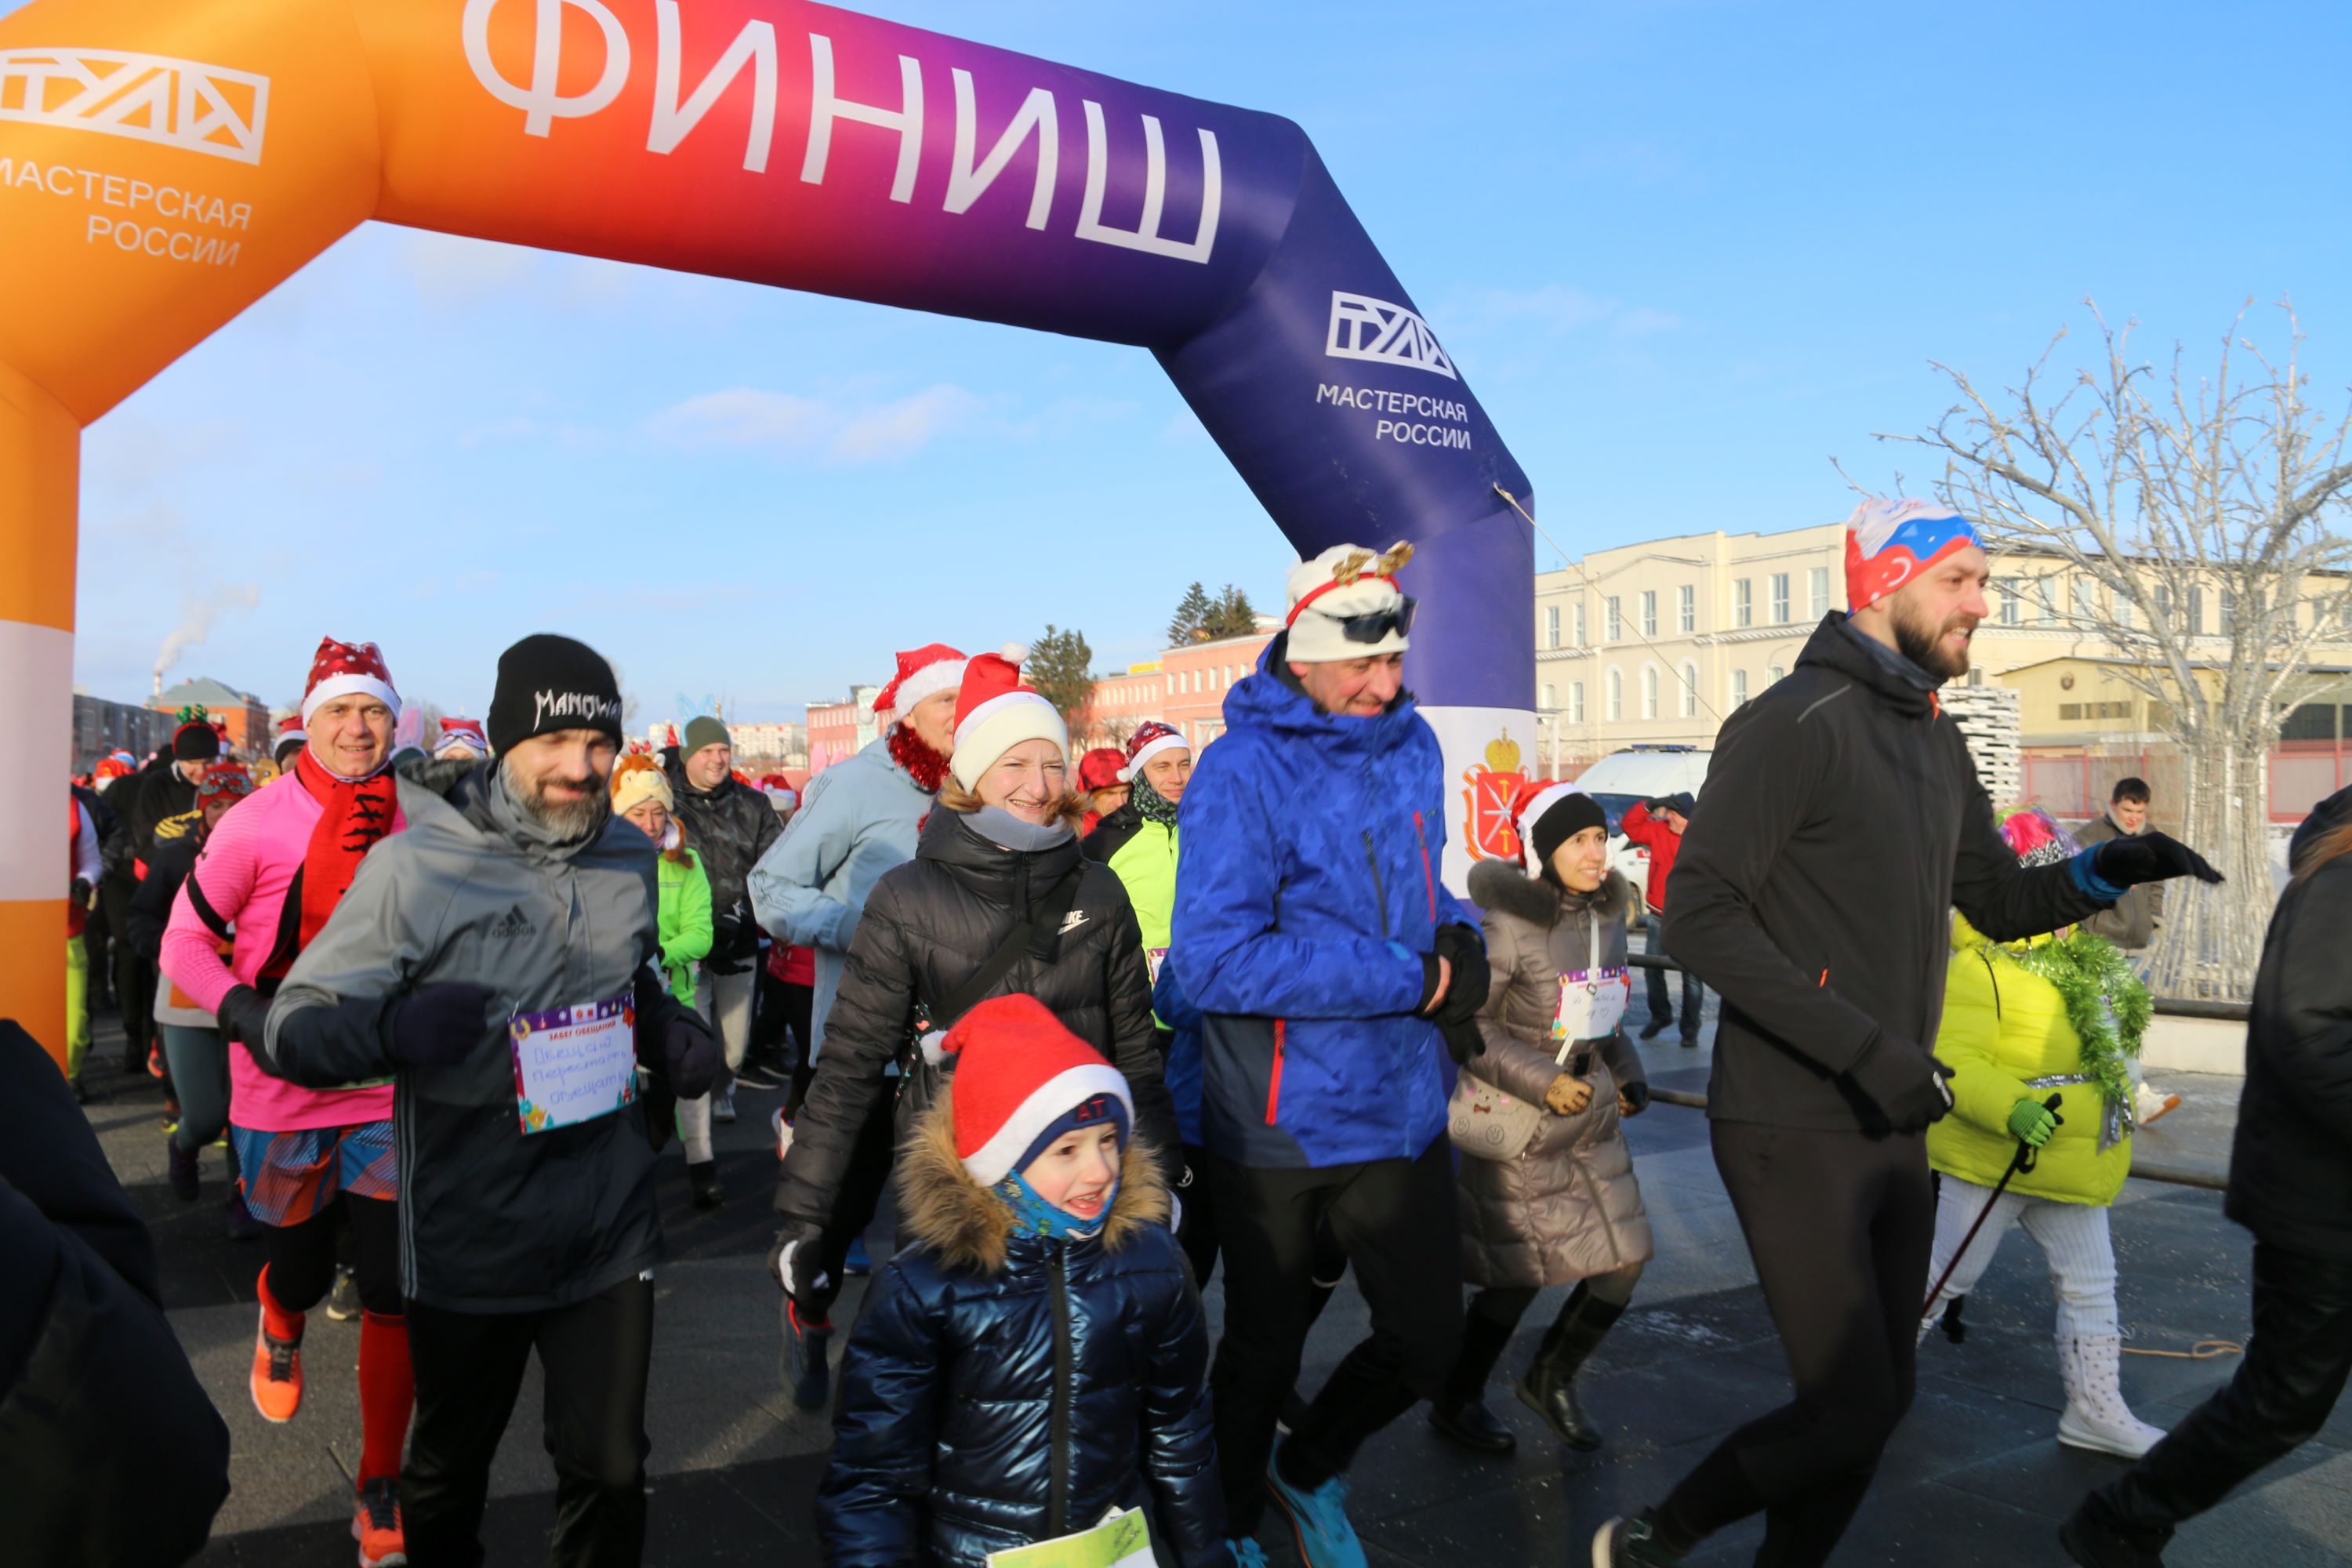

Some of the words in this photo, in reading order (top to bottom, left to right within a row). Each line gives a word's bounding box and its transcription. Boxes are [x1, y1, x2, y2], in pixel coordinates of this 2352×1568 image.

[462, 0, 1222, 264] ФИНИШ
[86, 214, 241, 267] РОССИИ
[1316, 383, 1468, 423] МАСТЕРСКАЯ
[1375, 419, 1472, 450] РОССИИ
